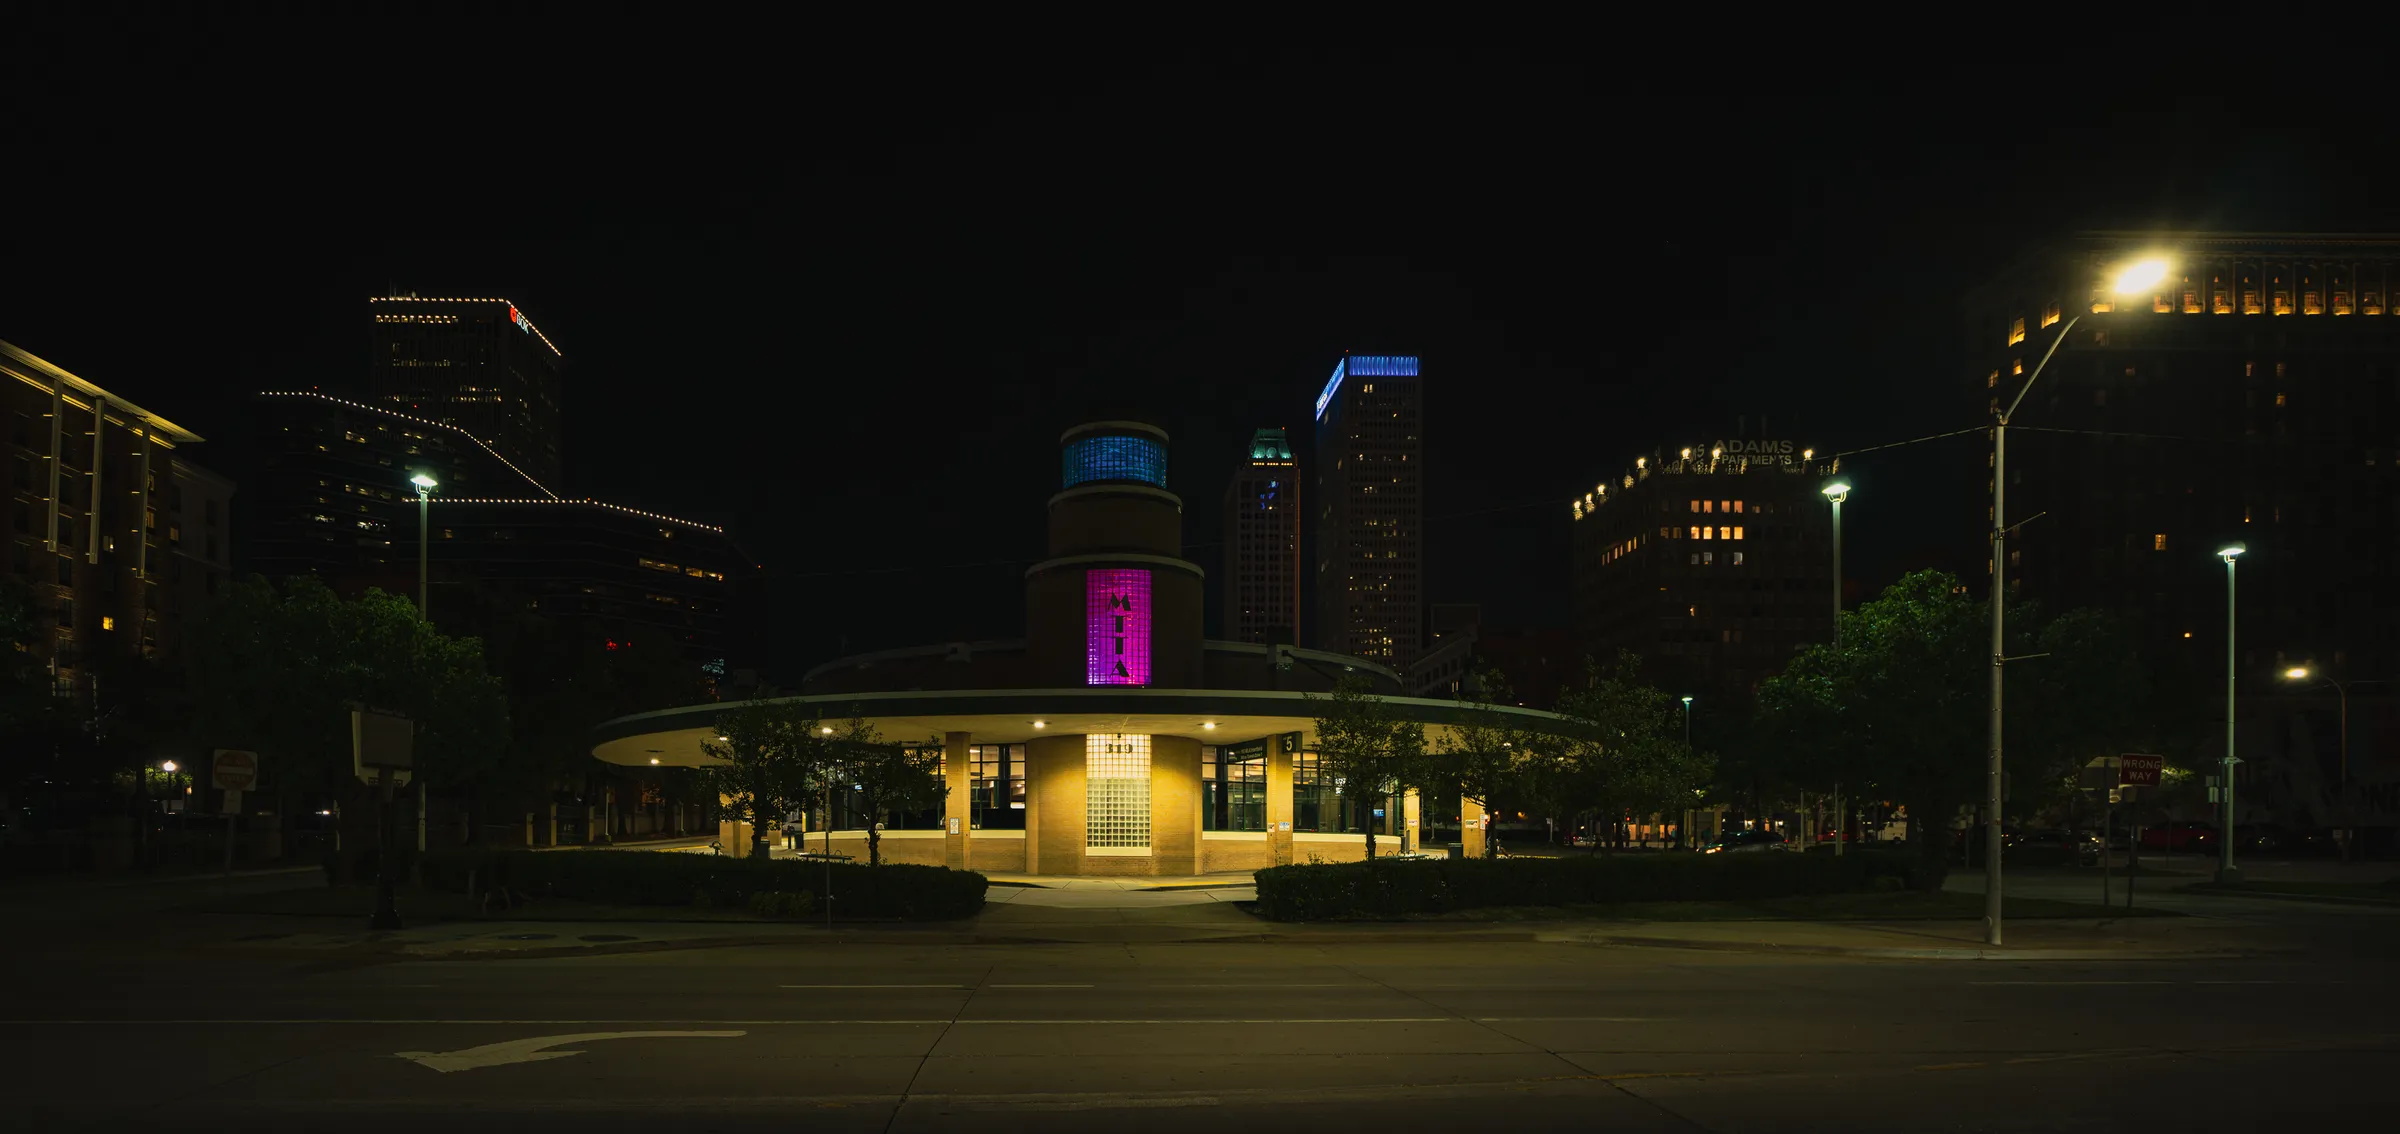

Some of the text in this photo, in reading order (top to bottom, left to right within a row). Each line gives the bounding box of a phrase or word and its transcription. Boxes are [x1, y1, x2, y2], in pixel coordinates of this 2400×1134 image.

[516, 313, 529, 335] BOK
[1713, 439, 1794, 454] ADAMS
[1714, 454, 1792, 465] PARTMENTS
[1105, 743, 1134, 754] 319
[1286, 735, 1293, 752] 5
[2123, 759, 2161, 770] WRONG
[2129, 771, 2153, 781] WAY
